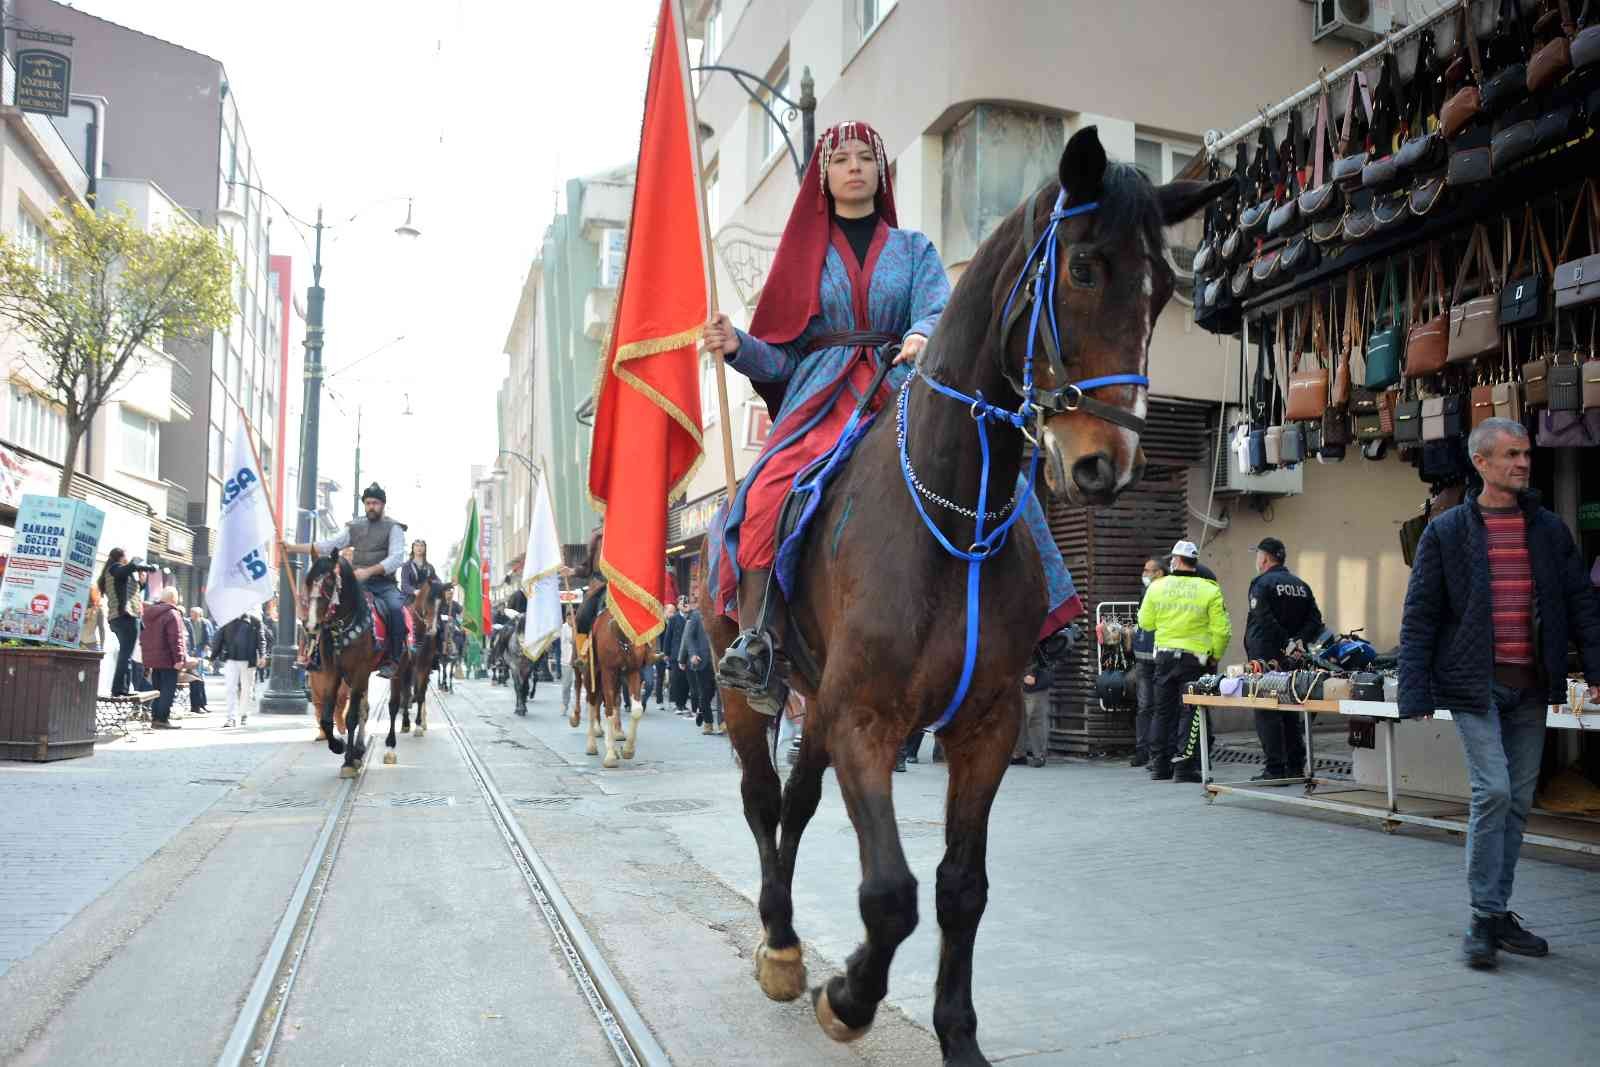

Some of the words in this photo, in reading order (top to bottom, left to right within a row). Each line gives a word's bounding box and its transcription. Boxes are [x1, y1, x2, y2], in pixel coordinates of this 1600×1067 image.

[22, 523, 65, 537] BAHARDA
[25, 534, 58, 546] GÖZLER
[16, 544, 62, 557] BURSA'DA
